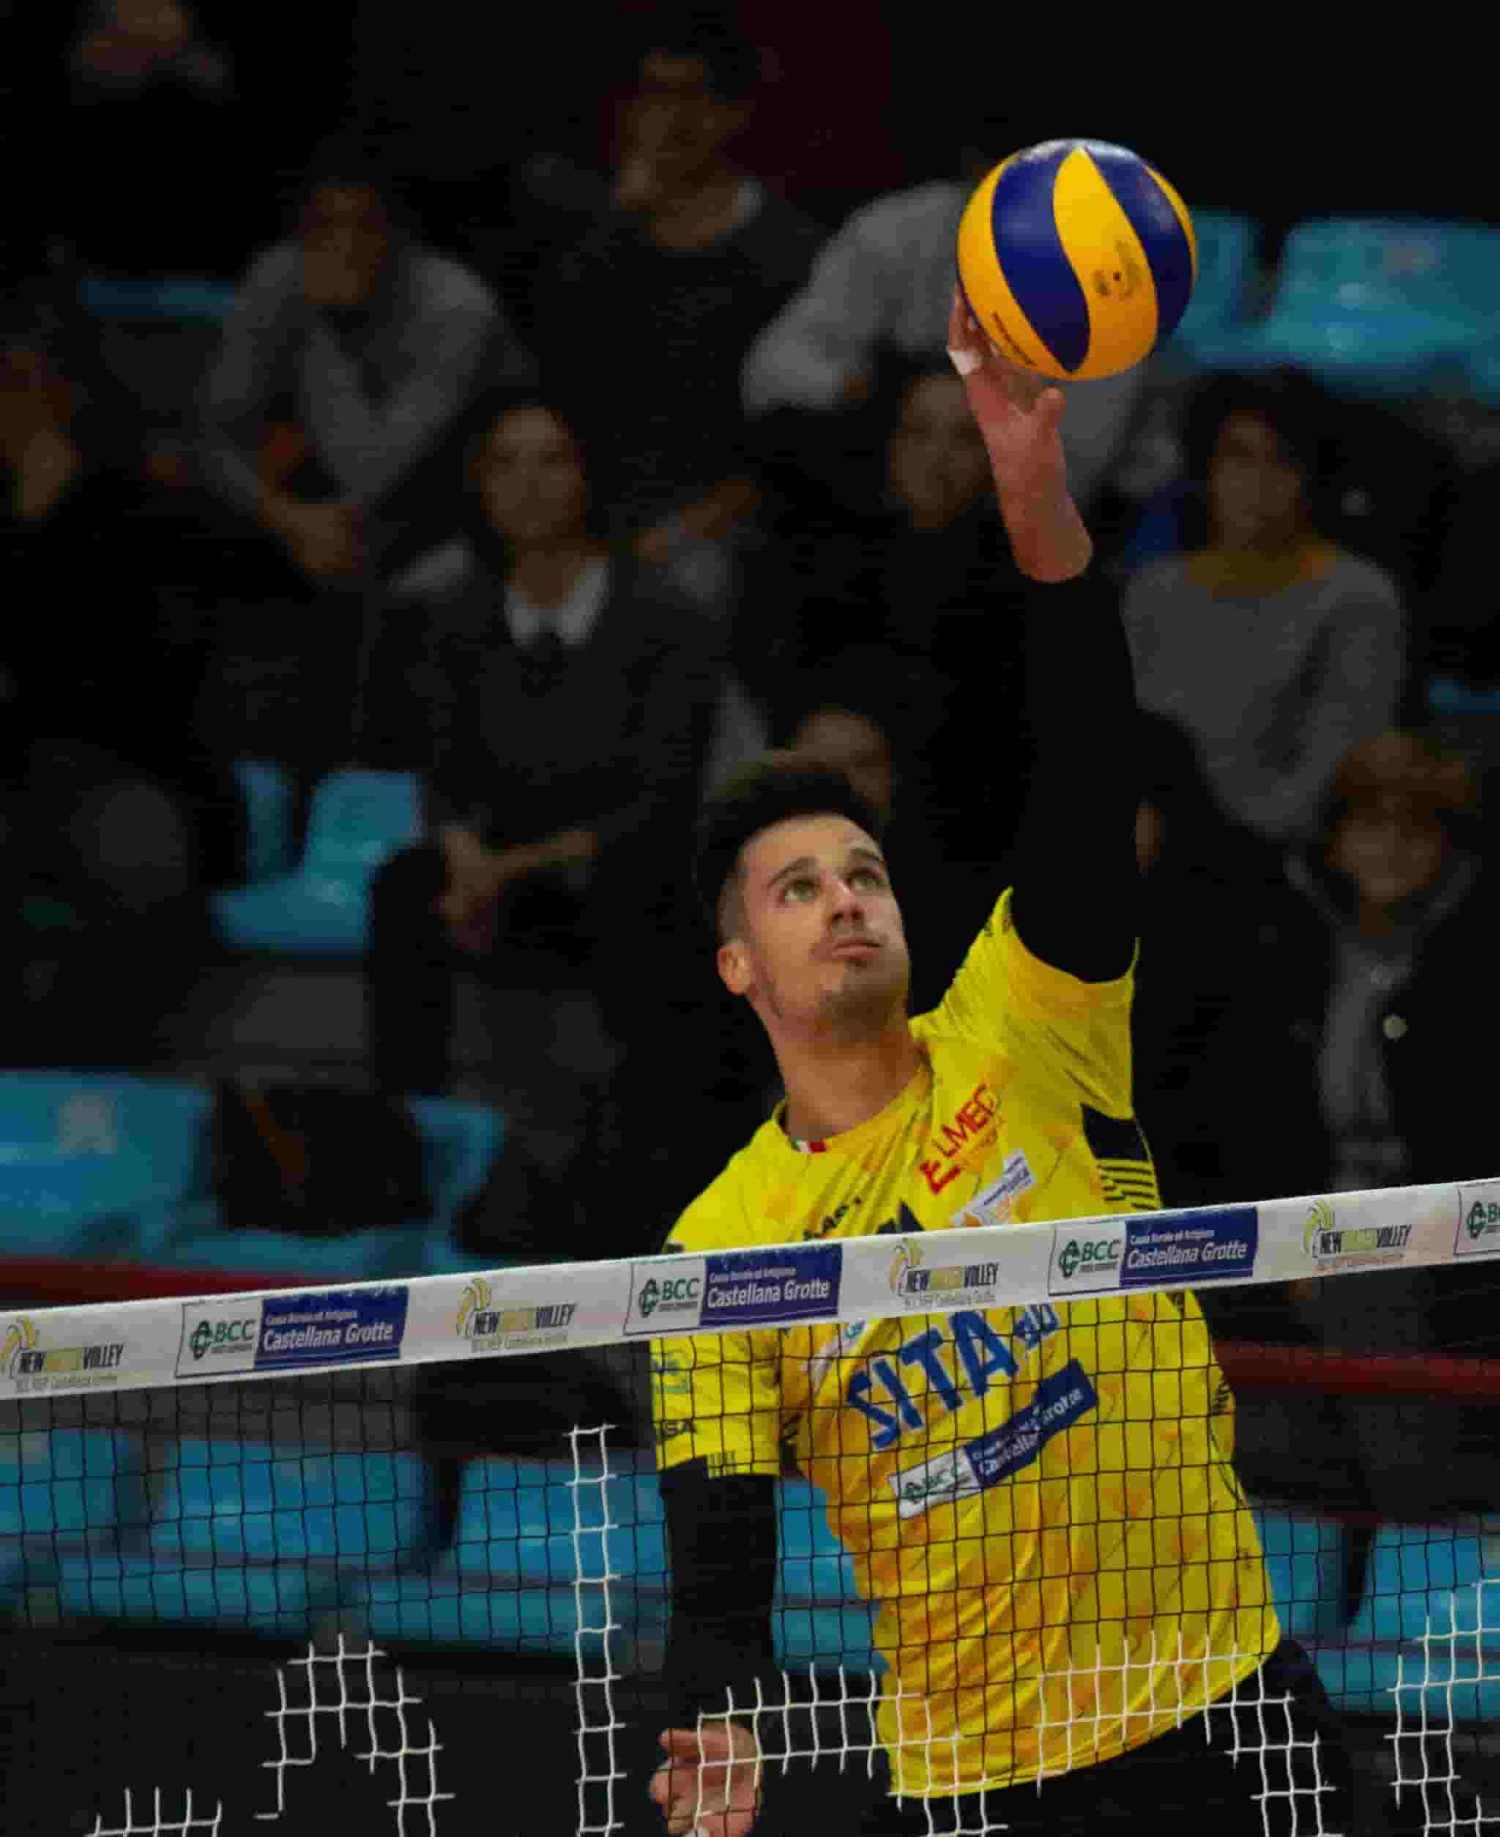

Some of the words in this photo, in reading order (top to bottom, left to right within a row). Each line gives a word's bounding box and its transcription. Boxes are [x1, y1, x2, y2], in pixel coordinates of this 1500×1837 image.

[1081, 1239, 1122, 1262] BCC
[1126, 1245, 1199, 1269] Castellana
[1202, 1239, 1248, 1262] Grotte
[661, 1276, 700, 1301] BCC
[707, 1284, 781, 1309] Castellana
[784, 1278, 831, 1301] Grotte
[213, 1318, 257, 1344] BCC
[262, 1325, 341, 1351] Castellana
[345, 1321, 394, 1344] Grotte
[473, 1311, 500, 1336] NEW
[82, 1341, 125, 1371] VOLLEY
[848, 1307, 1018, 1449] SITA
